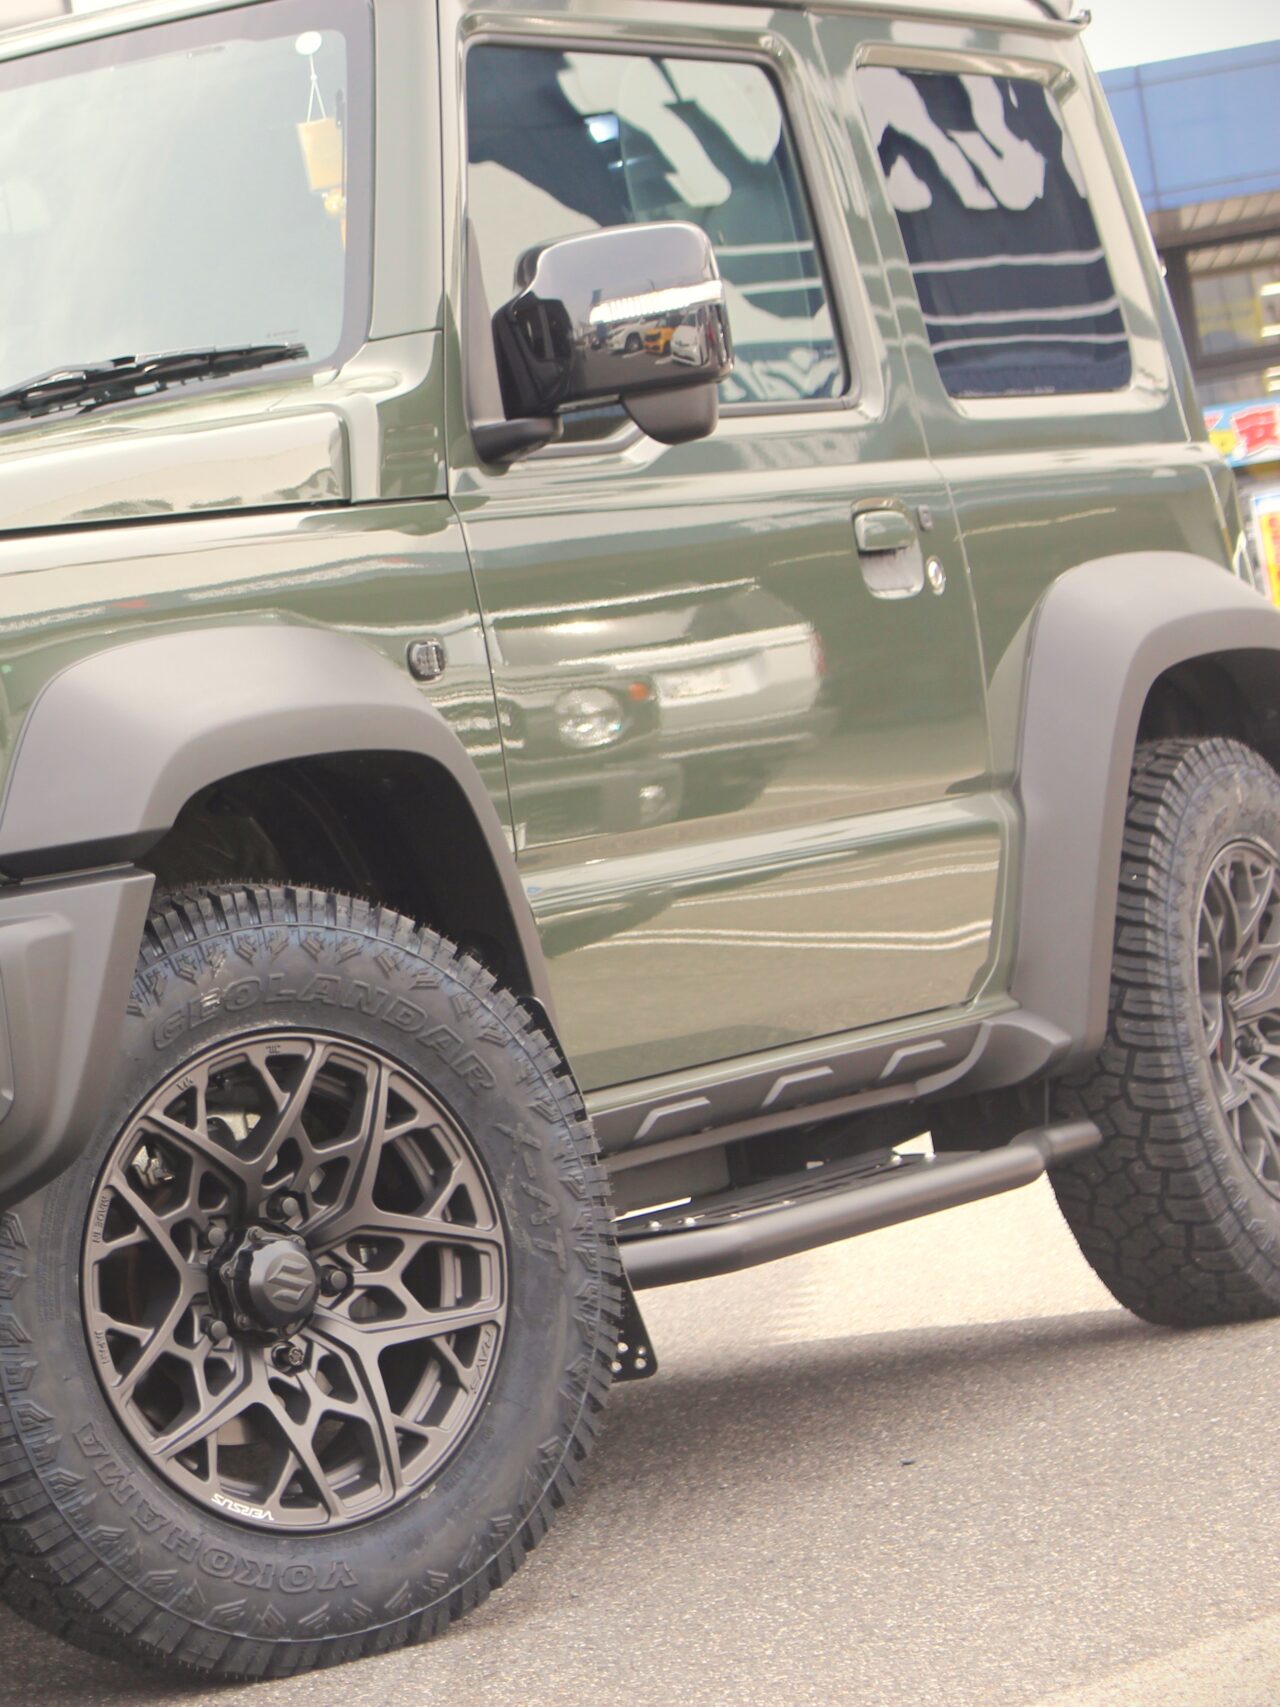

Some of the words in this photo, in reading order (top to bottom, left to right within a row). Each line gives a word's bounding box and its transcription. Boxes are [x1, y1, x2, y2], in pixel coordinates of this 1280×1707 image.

[154, 972, 496, 1093] GEOLANDAR
[72, 1421, 359, 1594] YOKOHAMA
[211, 1493, 274, 1521] VERSUS
